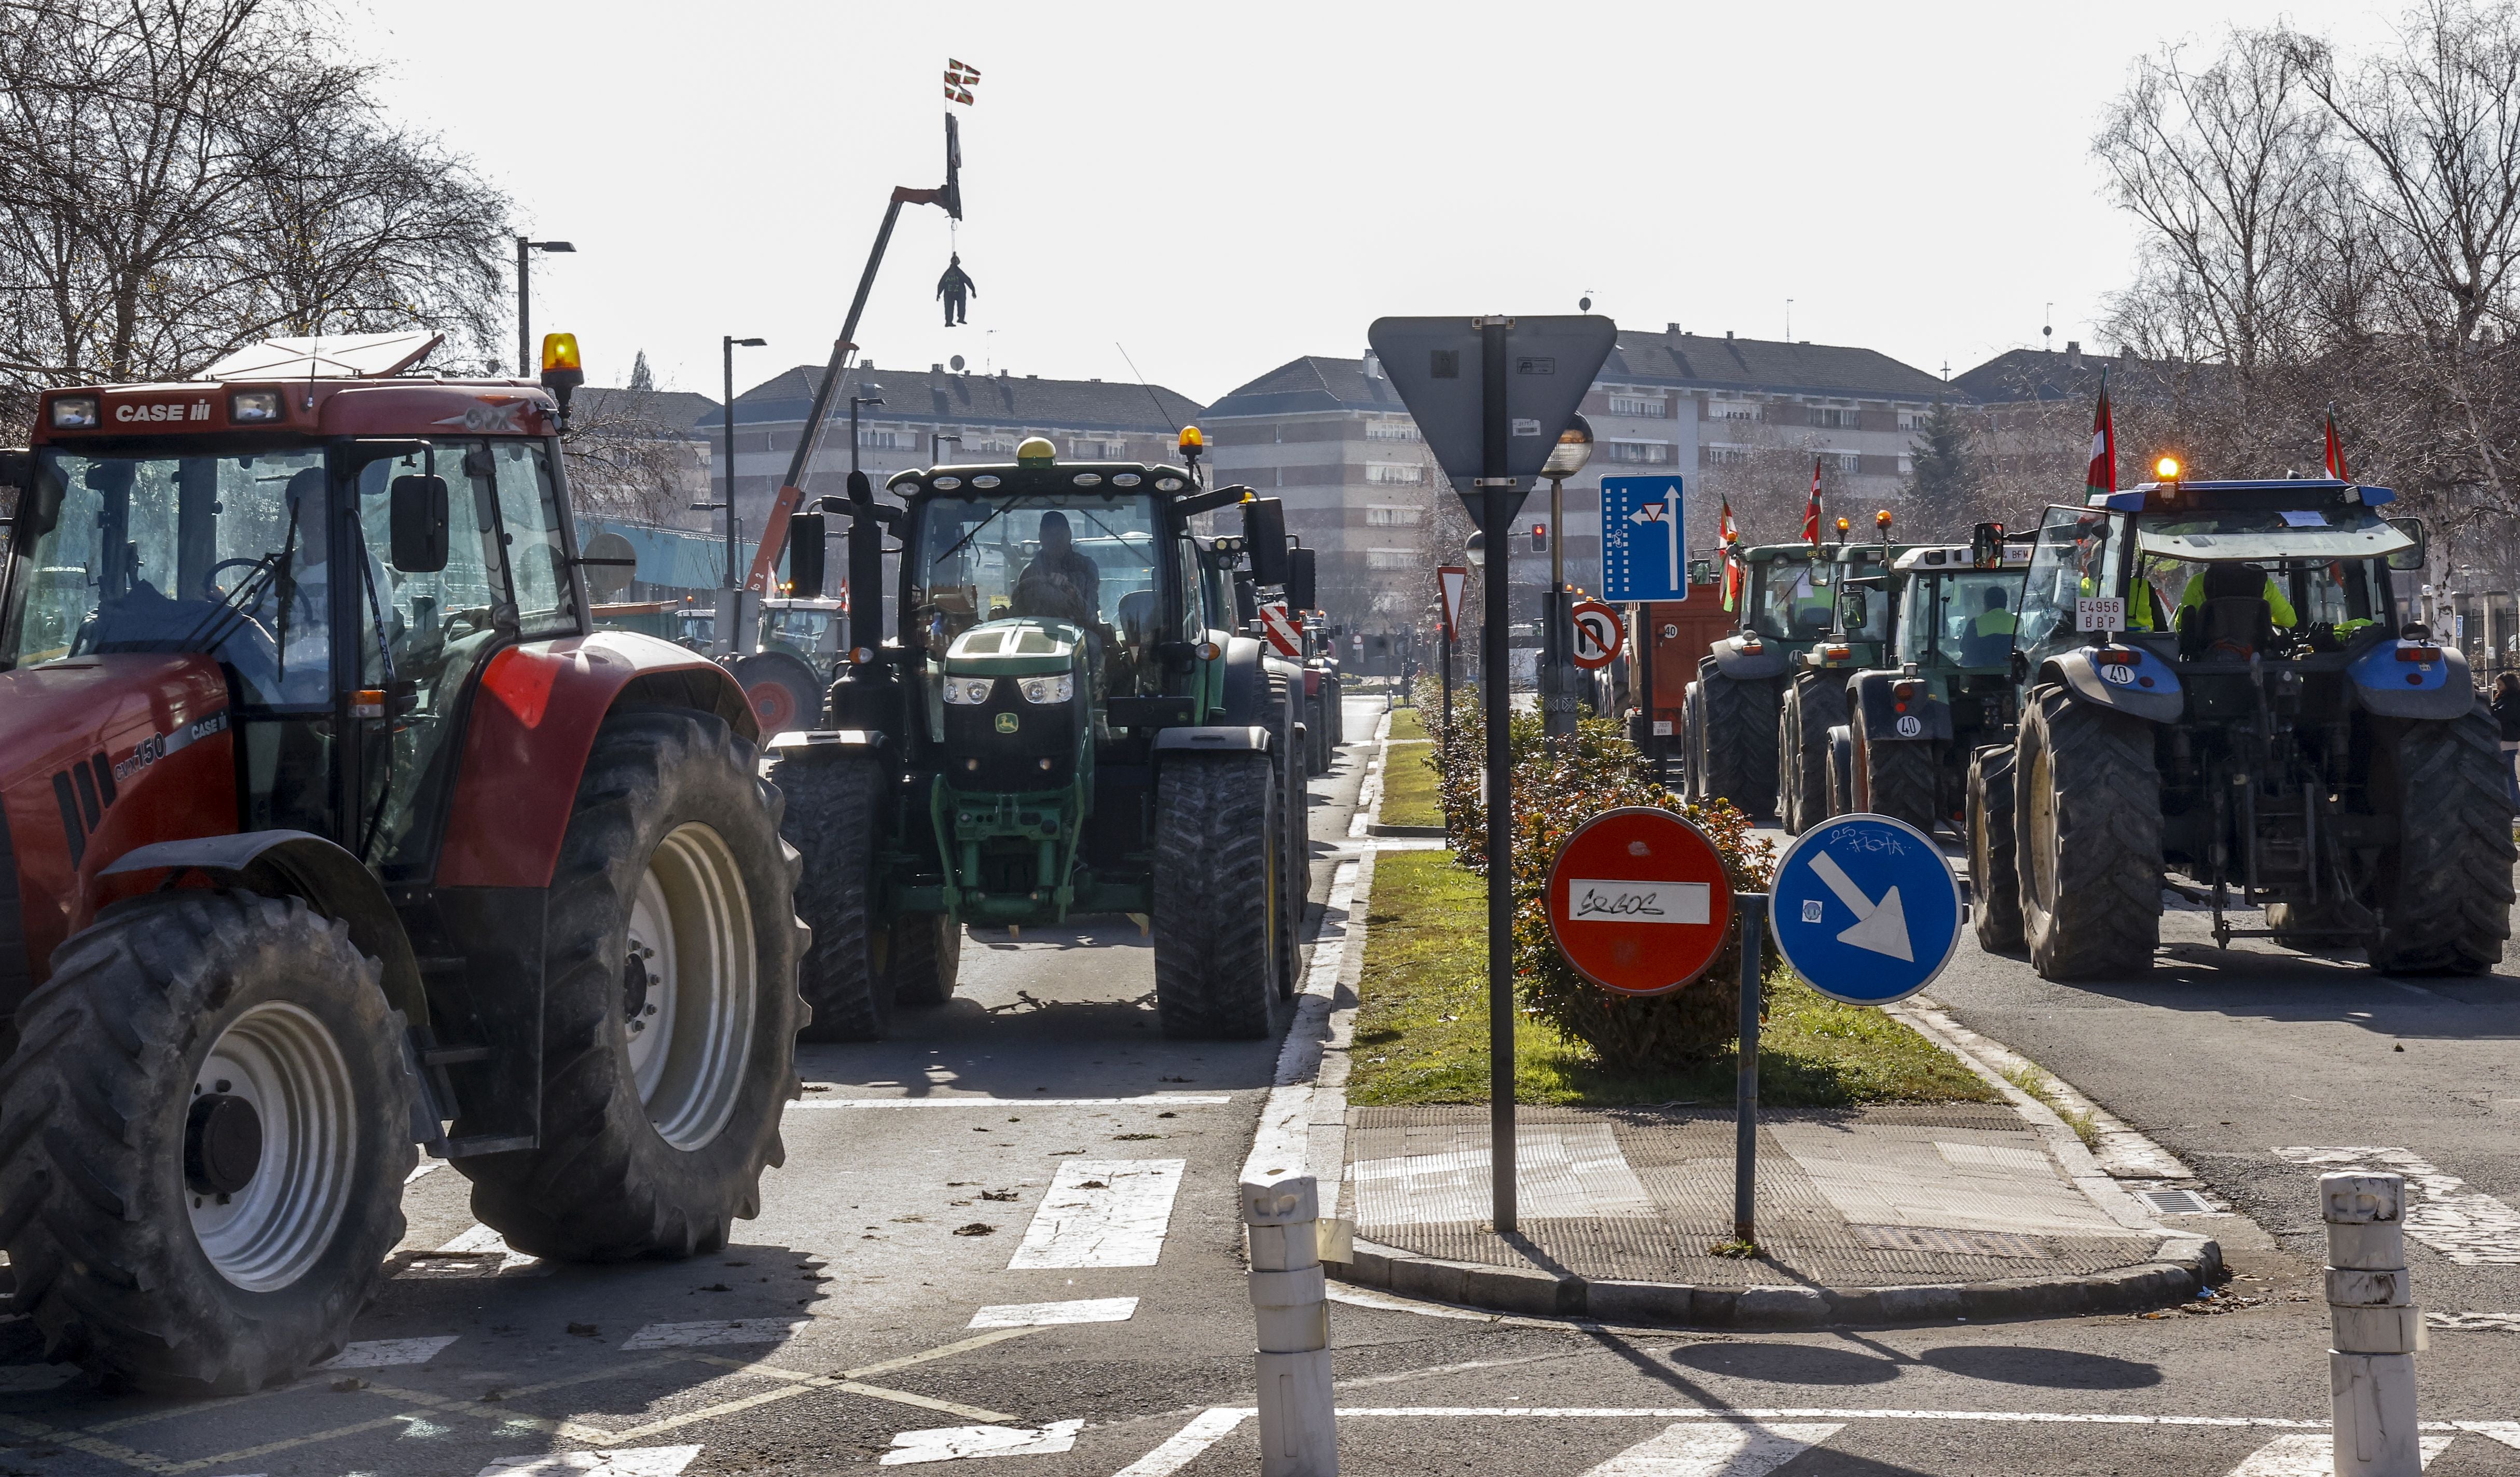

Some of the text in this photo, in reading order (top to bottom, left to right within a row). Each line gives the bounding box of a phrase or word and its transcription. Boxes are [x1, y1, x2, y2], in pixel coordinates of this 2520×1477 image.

[116, 405, 185, 422] CASE
[2012, 550, 2028, 559] BFM
[2080, 601, 2119, 612] E4956
[2086, 617, 2115, 628] BBP
[1665, 626, 1676, 636] 40
[2110, 666, 2128, 682] 40
[191, 719, 217, 740] CASE
[1902, 717, 1916, 735] 40
[1829, 826, 1856, 844] 25
